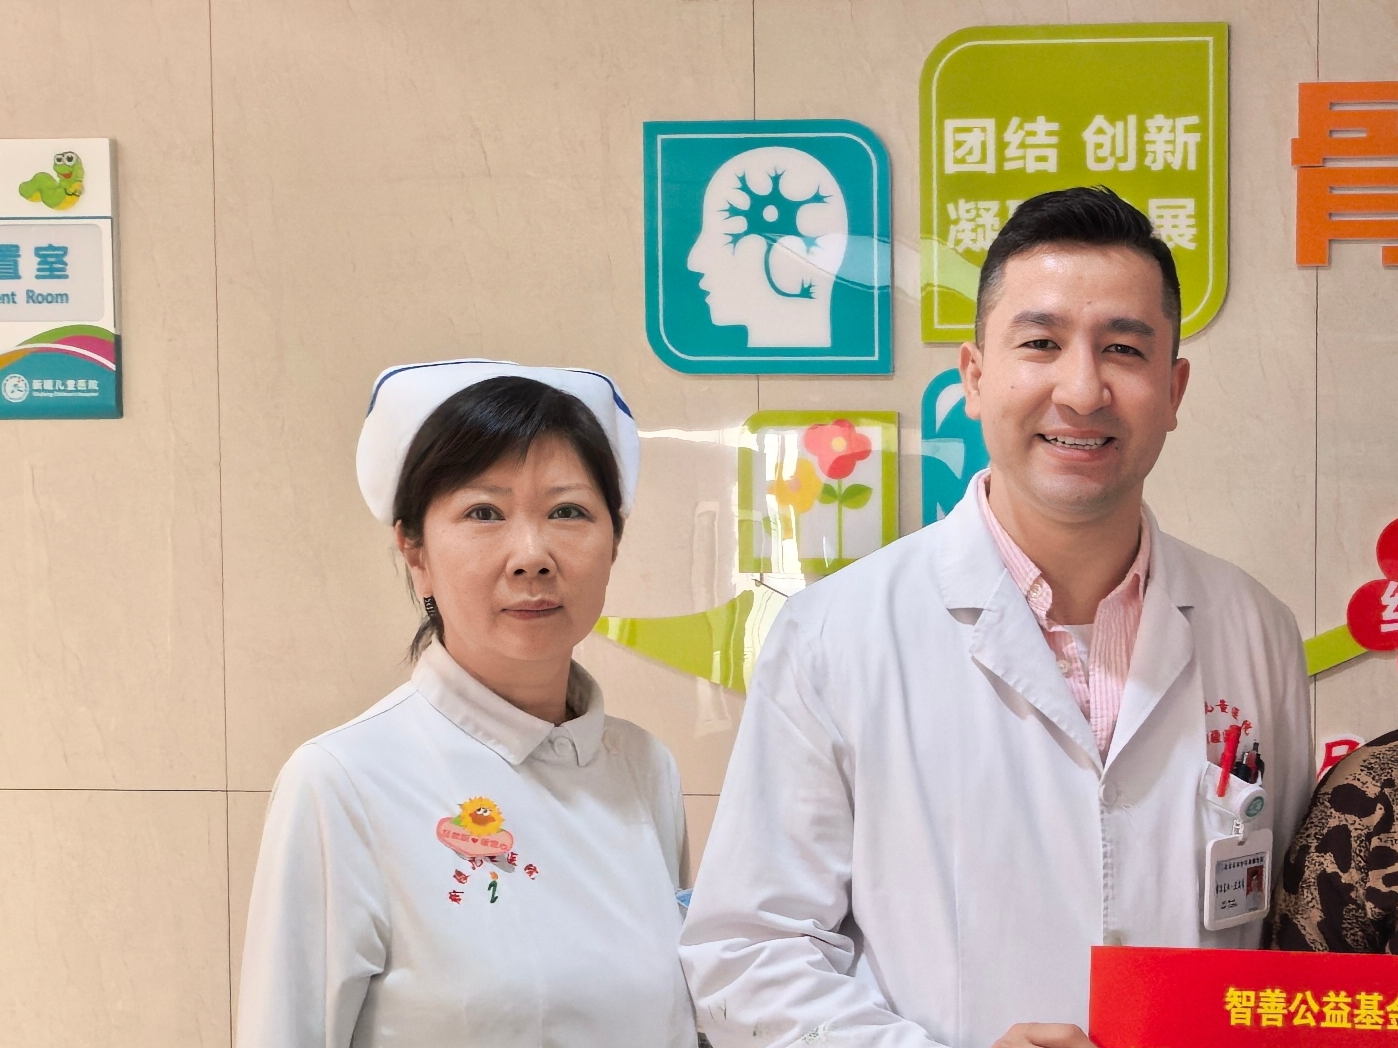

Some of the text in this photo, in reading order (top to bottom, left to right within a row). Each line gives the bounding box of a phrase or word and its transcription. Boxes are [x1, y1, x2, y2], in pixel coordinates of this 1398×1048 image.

[944, 114, 1201, 174] 团结 创新
[946, 199, 1023, 252] 凝
[26, 289, 69, 304] Room
